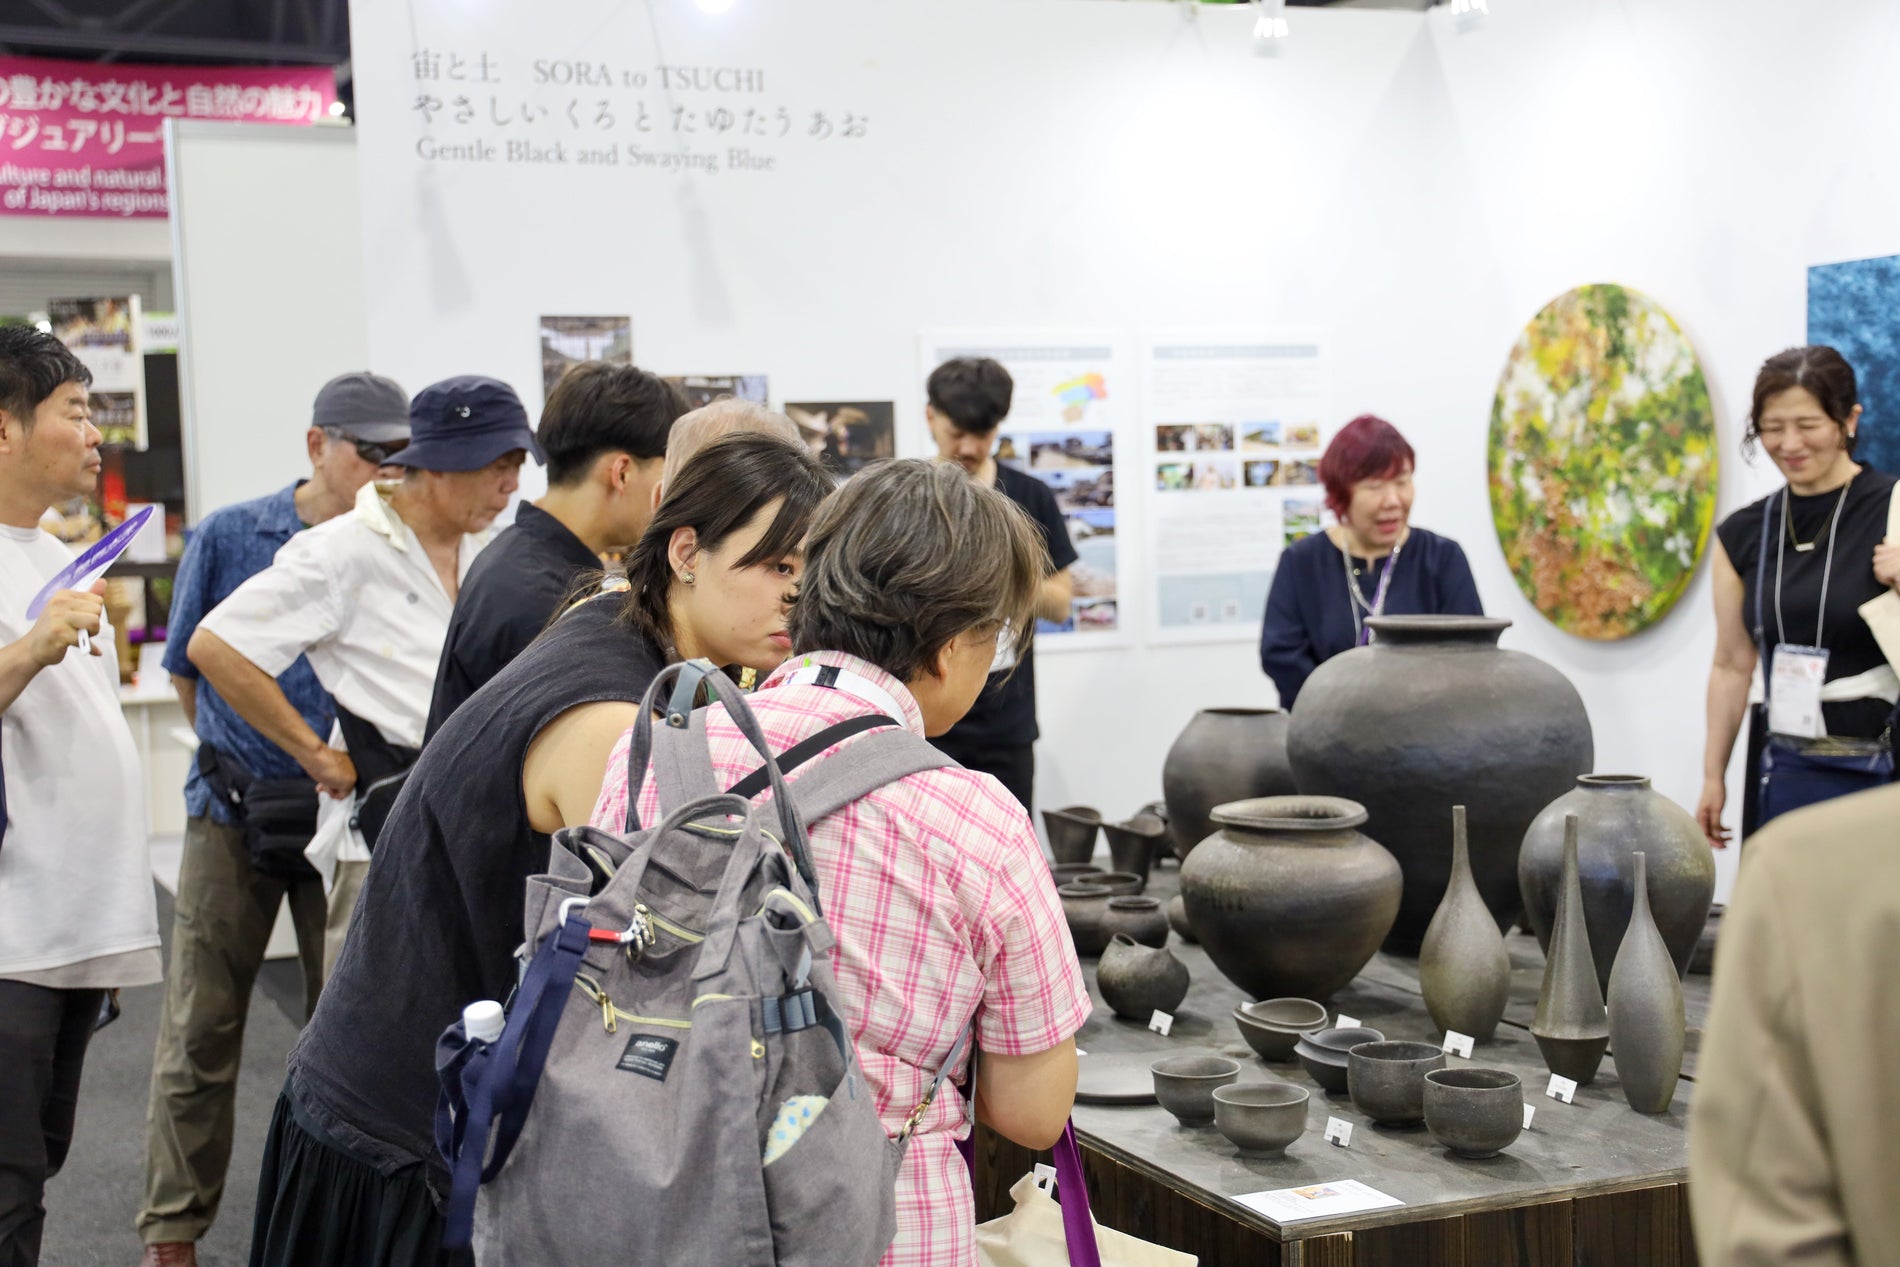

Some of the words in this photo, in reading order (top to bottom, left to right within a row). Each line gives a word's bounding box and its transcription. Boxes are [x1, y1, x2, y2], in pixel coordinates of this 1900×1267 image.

[533, 58, 613, 87] SORA
[622, 69, 648, 89] to
[656, 65, 764, 93] TSUCHI
[0, 113, 164, 155] ジュアリー
[417, 136, 496, 162] Gentle
[506, 139, 569, 164] Black
[577, 143, 619, 166] and
[627, 143, 719, 175] Swaying
[727, 147, 776, 171] Blue
[53, 164, 92, 188] and
[93, 166, 161, 189] natural
[4, 185, 27, 209] of
[28, 186, 101, 214] Japan's
